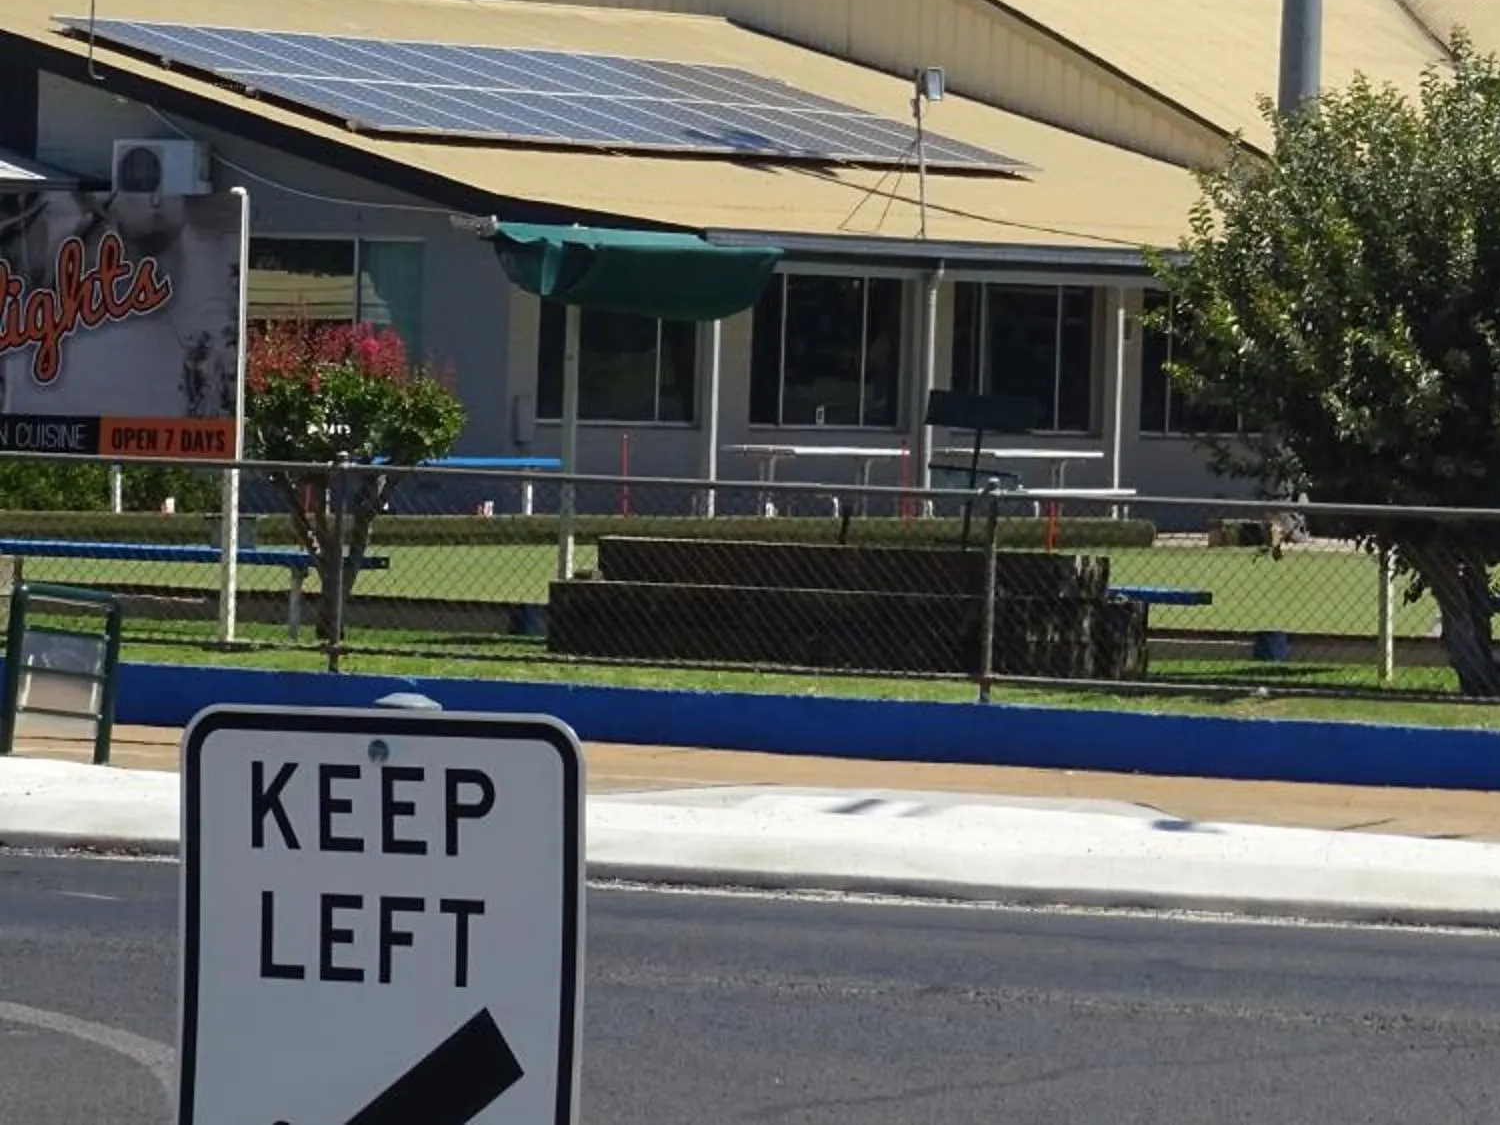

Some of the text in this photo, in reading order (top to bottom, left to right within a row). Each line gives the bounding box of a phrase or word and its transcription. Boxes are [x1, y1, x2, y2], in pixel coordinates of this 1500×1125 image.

[14, 422, 88, 450] CUISINE
[111, 427, 226, 452] OPEN 7 DAYS
[251, 760, 495, 856] KEEP
[259, 890, 485, 988] LEFT
